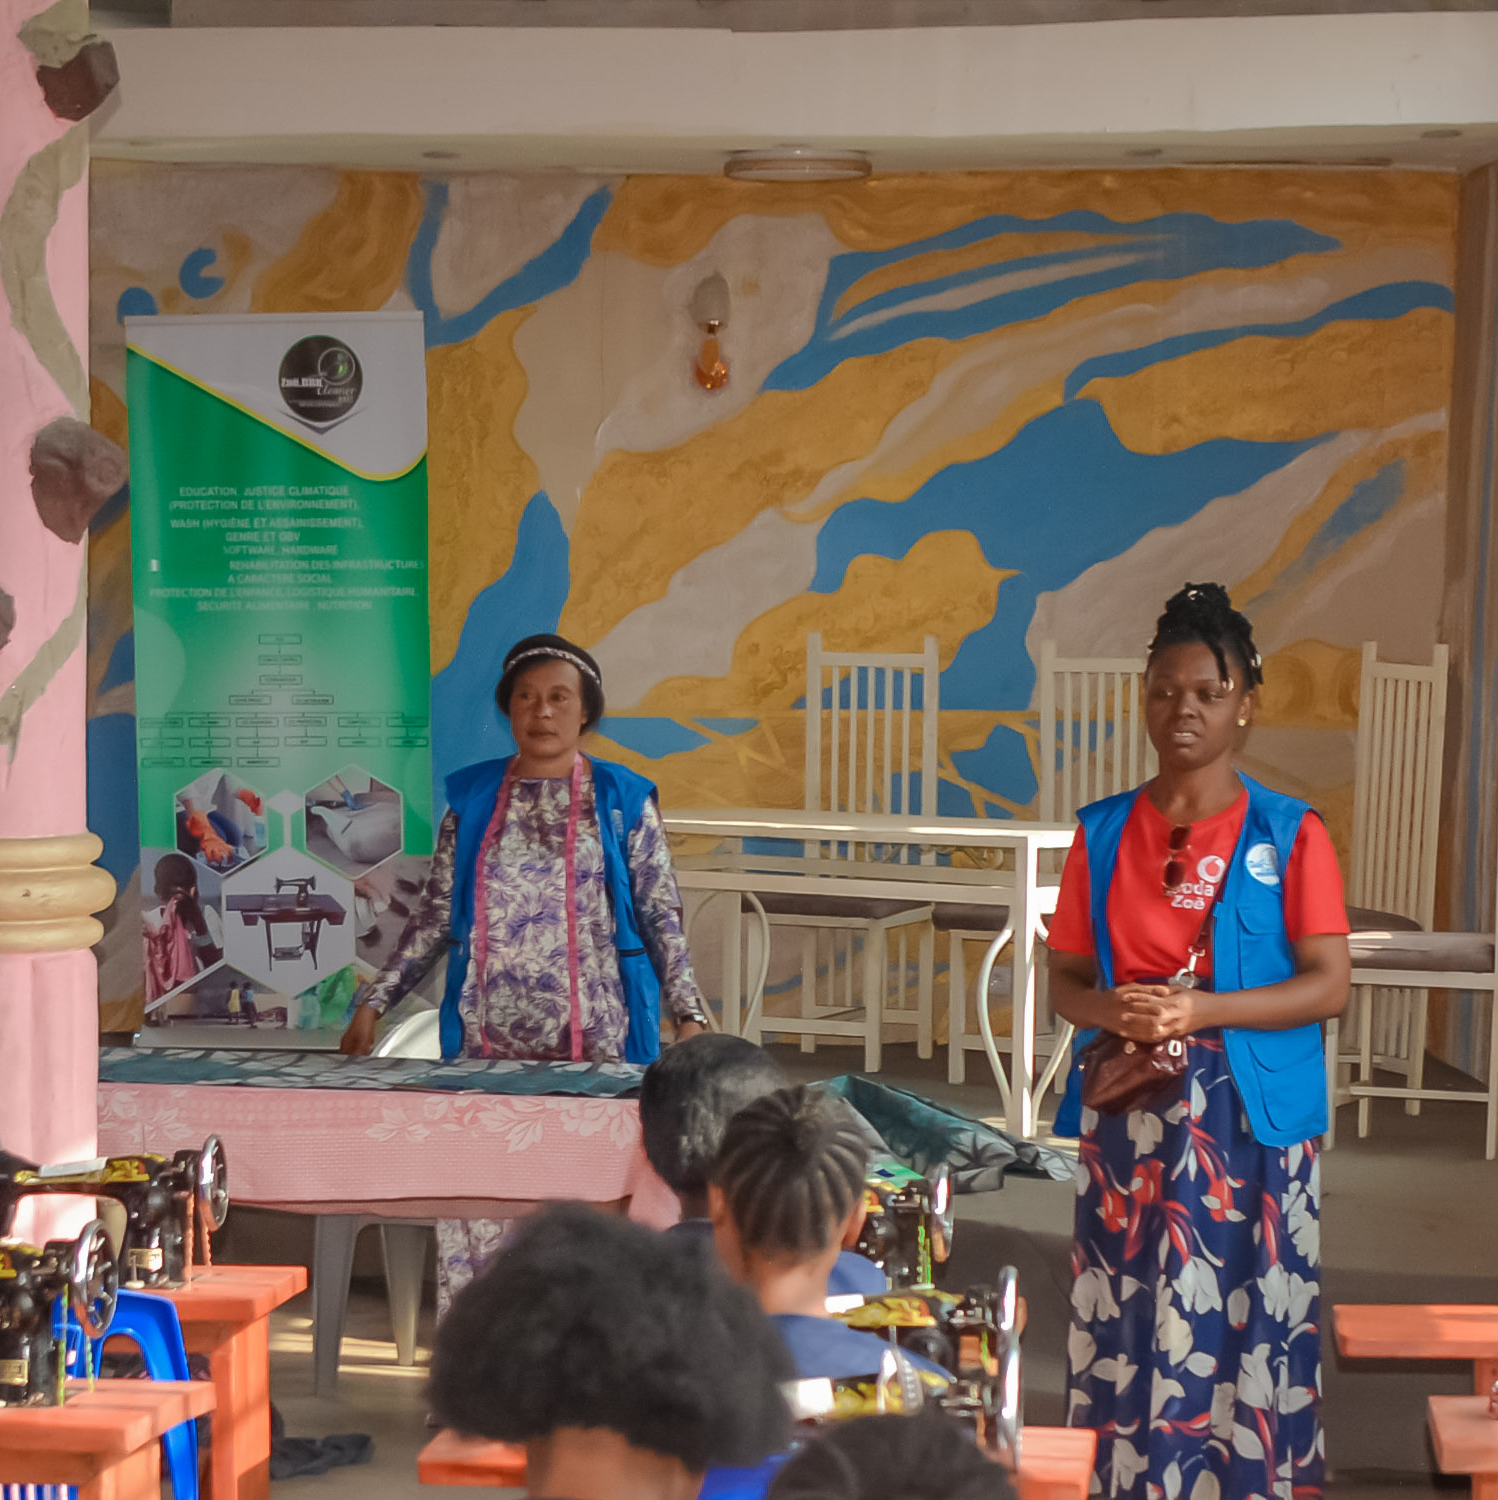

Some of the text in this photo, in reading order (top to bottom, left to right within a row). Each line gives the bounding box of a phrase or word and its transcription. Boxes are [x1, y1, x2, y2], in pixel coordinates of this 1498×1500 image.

[244, 485, 286, 497] JUSTICE
[288, 485, 350, 497] CLIMATIQUE
[169, 499, 239, 511] (PROTECTION
[240, 499, 255, 511] DE
[170, 518, 200, 529] WASH
[253, 517, 268, 529] ET
[225, 531, 260, 543] GENRE
[262, 531, 276, 543] ET
[281, 544, 339, 556] HARDWARE
[311, 559, 331, 570] DES
[296, 573, 333, 584] SOCIAL
[149, 587, 212, 599] PROTECTION
[214, 587, 228, 598] DE
[287, 586, 345, 598] LOGISTIQUE
[317, 599, 373, 611] NUTRITION
[1175, 879, 1215, 897] oda
